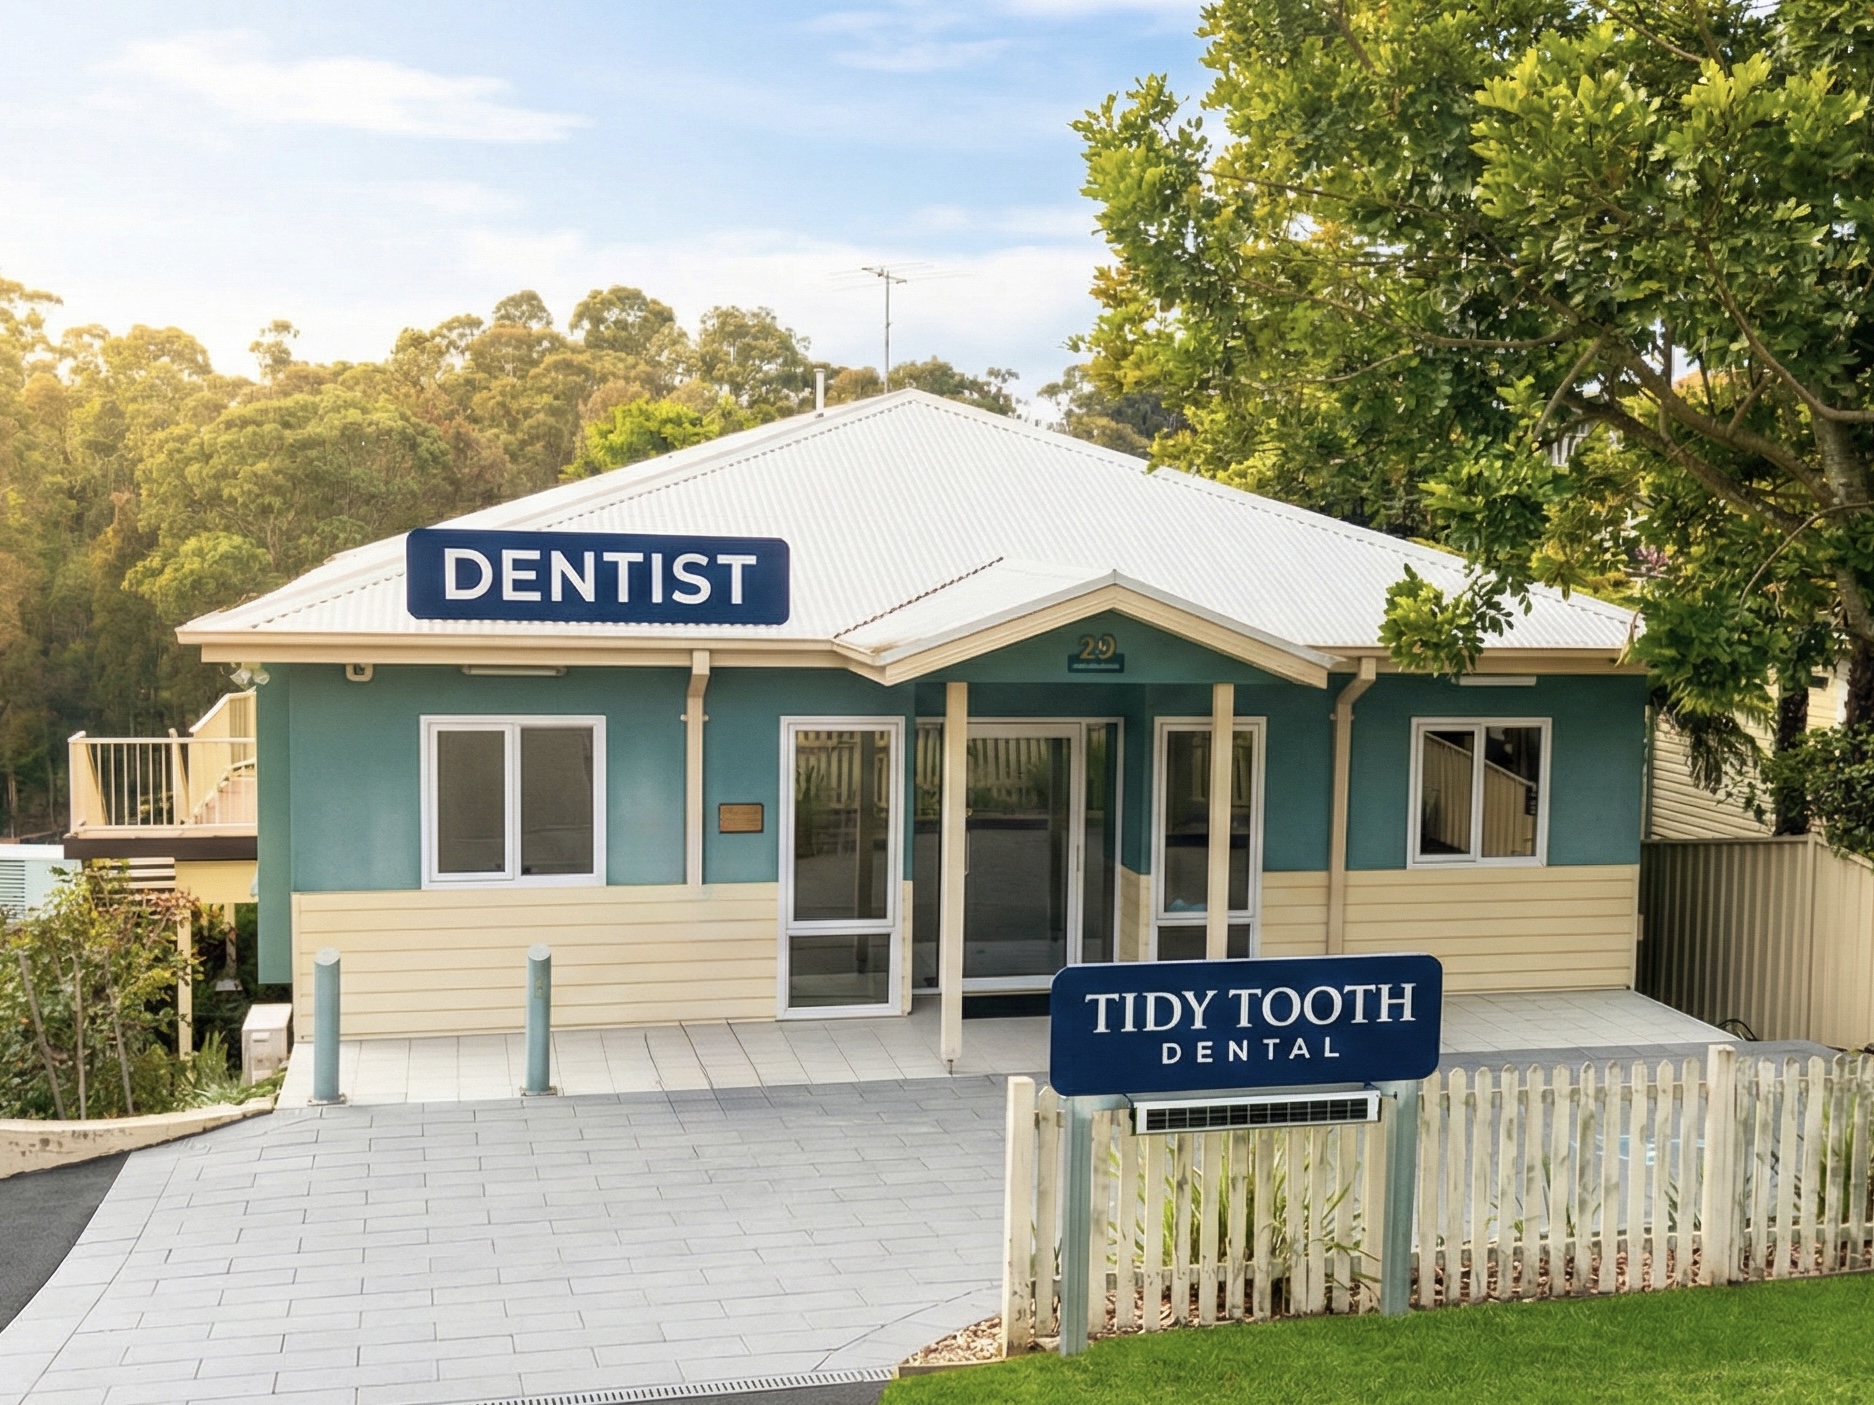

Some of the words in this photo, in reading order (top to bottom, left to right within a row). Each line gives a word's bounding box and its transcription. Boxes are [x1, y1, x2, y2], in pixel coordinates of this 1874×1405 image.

[444, 547, 757, 605] DENTIST
[1085, 990, 1218, 1033] TIDY
[1228, 983, 1417, 1028] TOOTH
[1162, 1036, 1340, 1065] DENTAL
